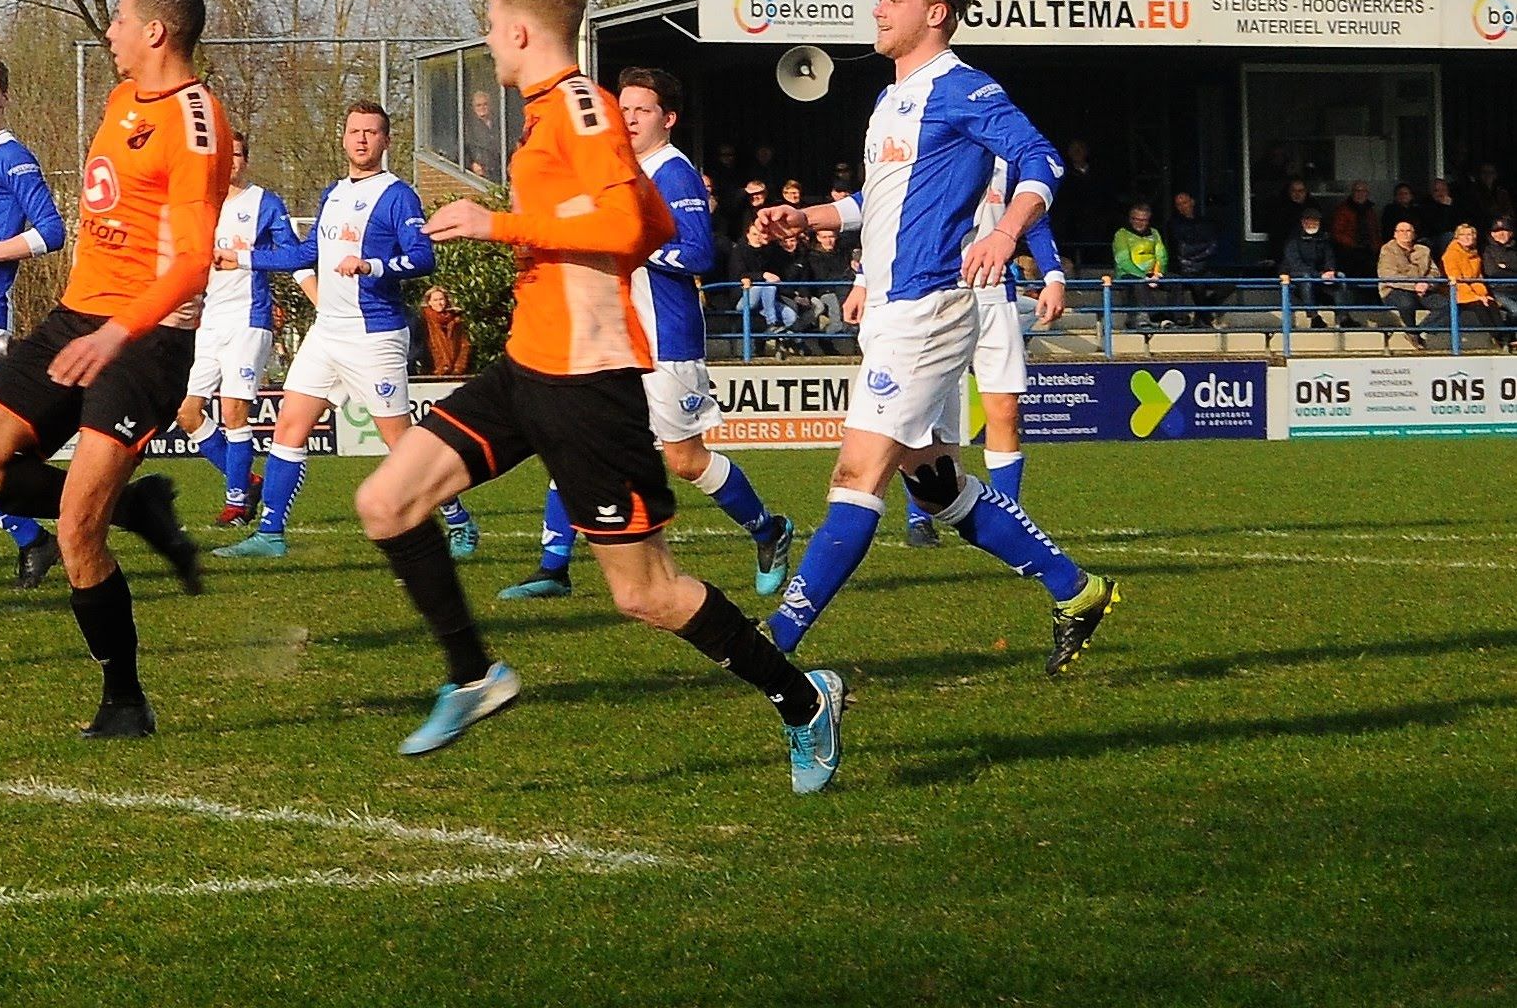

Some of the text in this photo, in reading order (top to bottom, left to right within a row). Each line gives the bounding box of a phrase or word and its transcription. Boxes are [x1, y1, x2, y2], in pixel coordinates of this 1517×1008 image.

[964, 0, 1190, 29] GJALTEMA.EU
[1488, 6, 1517, 24] bo
[1237, 19, 1401, 35] MATERIEEL VERHUUR
[1038, 373, 1095, 386] betekenis
[709, 379, 849, 412] JALTEM
[1194, 373, 1253, 408] d&u
[1296, 381, 1351, 404] ONS
[1432, 379, 1485, 402] ONS
[1296, 407, 1351, 417] VOOR JOU
[1431, 405, 1486, 414] VOOR JOU
[1500, 404, 1517, 413] VO
[785, 424, 796, 438] &
